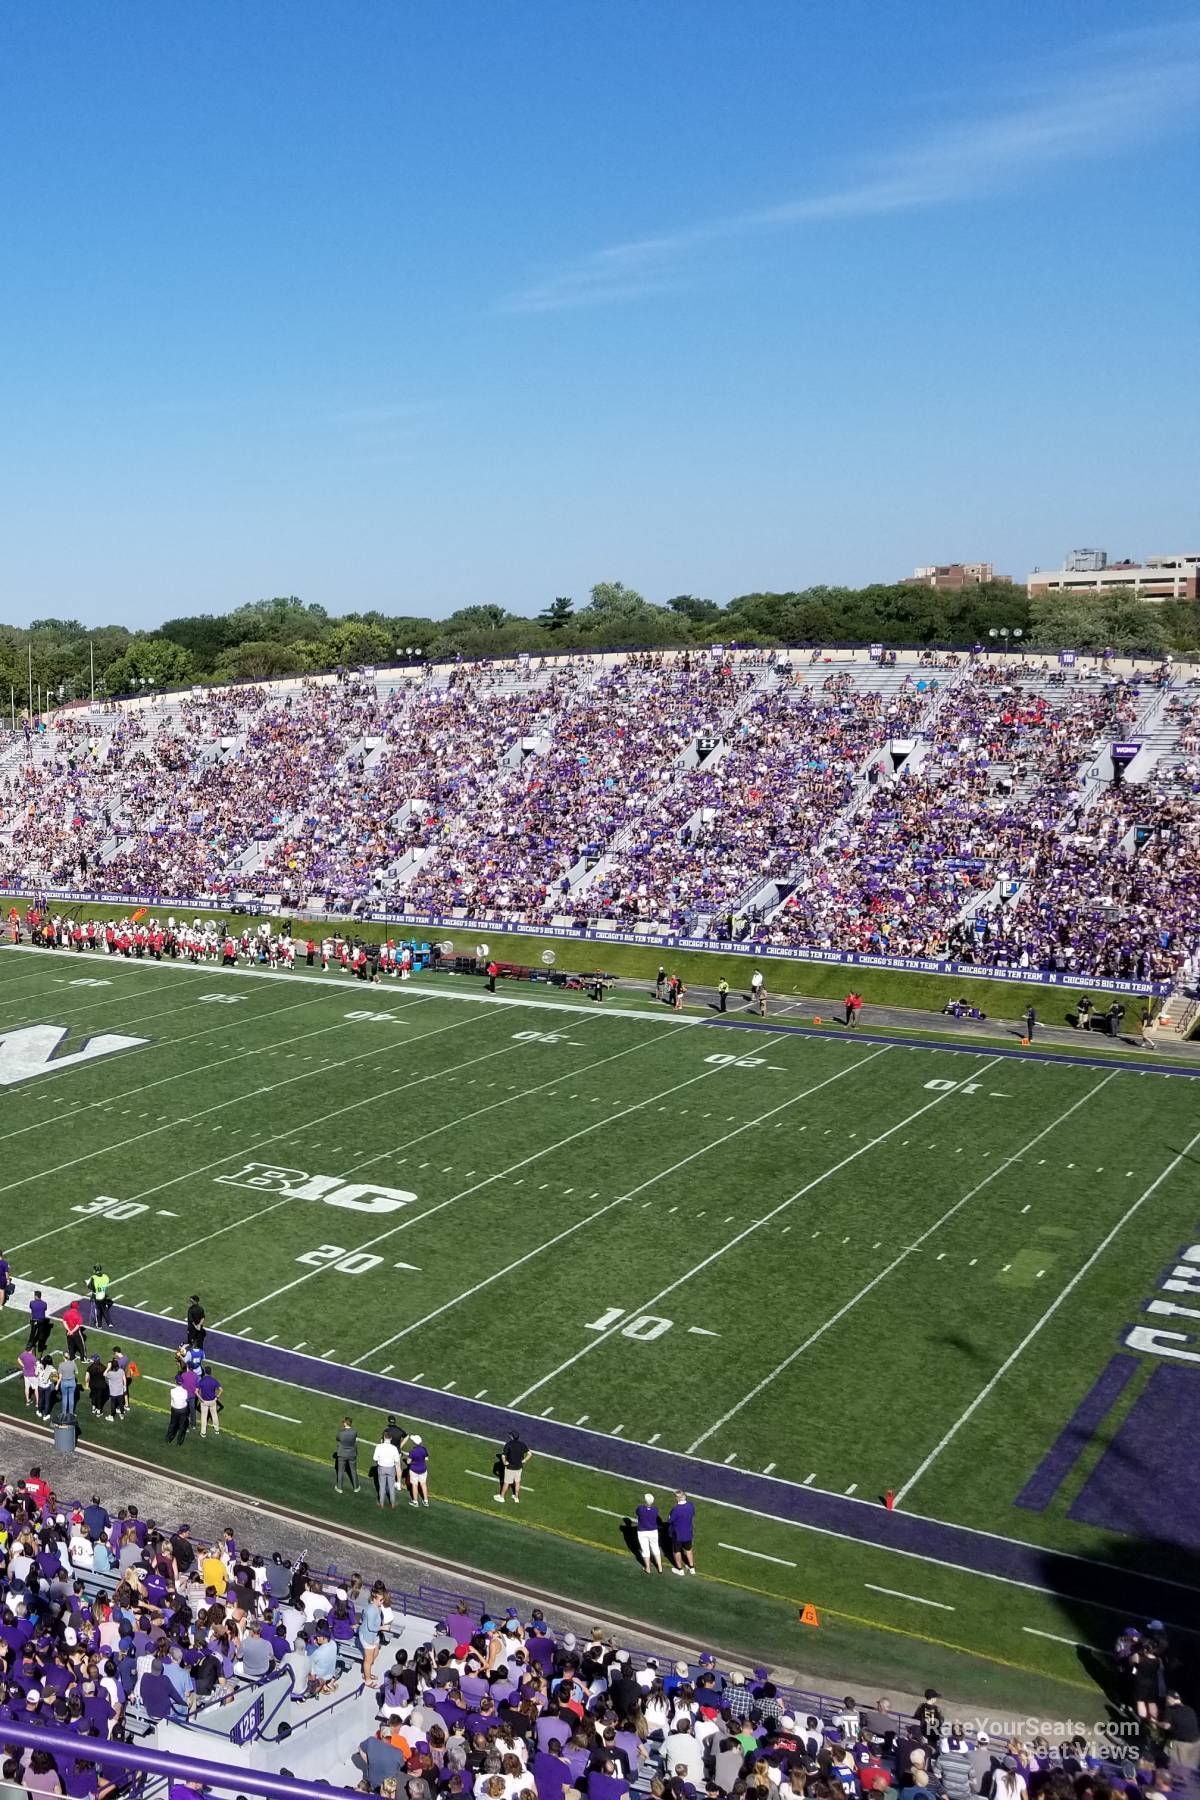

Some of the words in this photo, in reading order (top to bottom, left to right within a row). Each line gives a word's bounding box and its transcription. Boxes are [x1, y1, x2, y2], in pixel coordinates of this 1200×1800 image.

[596, 932, 624, 940] CHICAGO'S
[647, 936, 663, 944] TEAM
[668, 938, 674, 946] N
[679, 940, 708, 948] CHICAGO'S
[734, 944, 750, 952] TEAM
[755, 945, 761, 953] N
[766, 947, 797, 956] CHICAGO'S
[798, 949, 809, 958] BIG
[810, 950, 823, 959] TEN
[824, 952, 841, 960] TEAM
[847, 954, 853, 962] N
[859, 955, 892, 966] CHICAGO'S
[893, 958, 905, 966] BIG
[906, 960, 918, 968] TEN
[920, 961, 938, 970] TEAM
[945, 964, 952, 972] N
[958, 965, 993, 975] CHICAGO'S
[994, 968, 1006, 977] BIG
[1007, 969, 1021, 978] TEN
[1022, 971, 1043, 980] TEAM
[1050, 973, 1056, 983] N
[1063, 975, 1100, 986] CHICAGO'S
[1101, 979, 1114, 988] BIG
[1115, 980, 1131, 990] TEN
[1132, 982, 1153, 992] TEAM
[1160, 984, 1168, 993] N
[198, 993, 248, 1004] 50
[343, 1010, 398, 1022] 40
[511, 1030, 571, 1043] 30
[704, 1053, 768, 1068] 20
[922, 1078, 984, 1094] 10
[70, 1196, 150, 1220] 30
[295, 1244, 384, 1274] 20
[584, 1307, 674, 1340] 10
[806, 1612, 814, 1620] G
[239, 1708, 257, 1740] 126
[861, 1752, 870, 1764] 2
